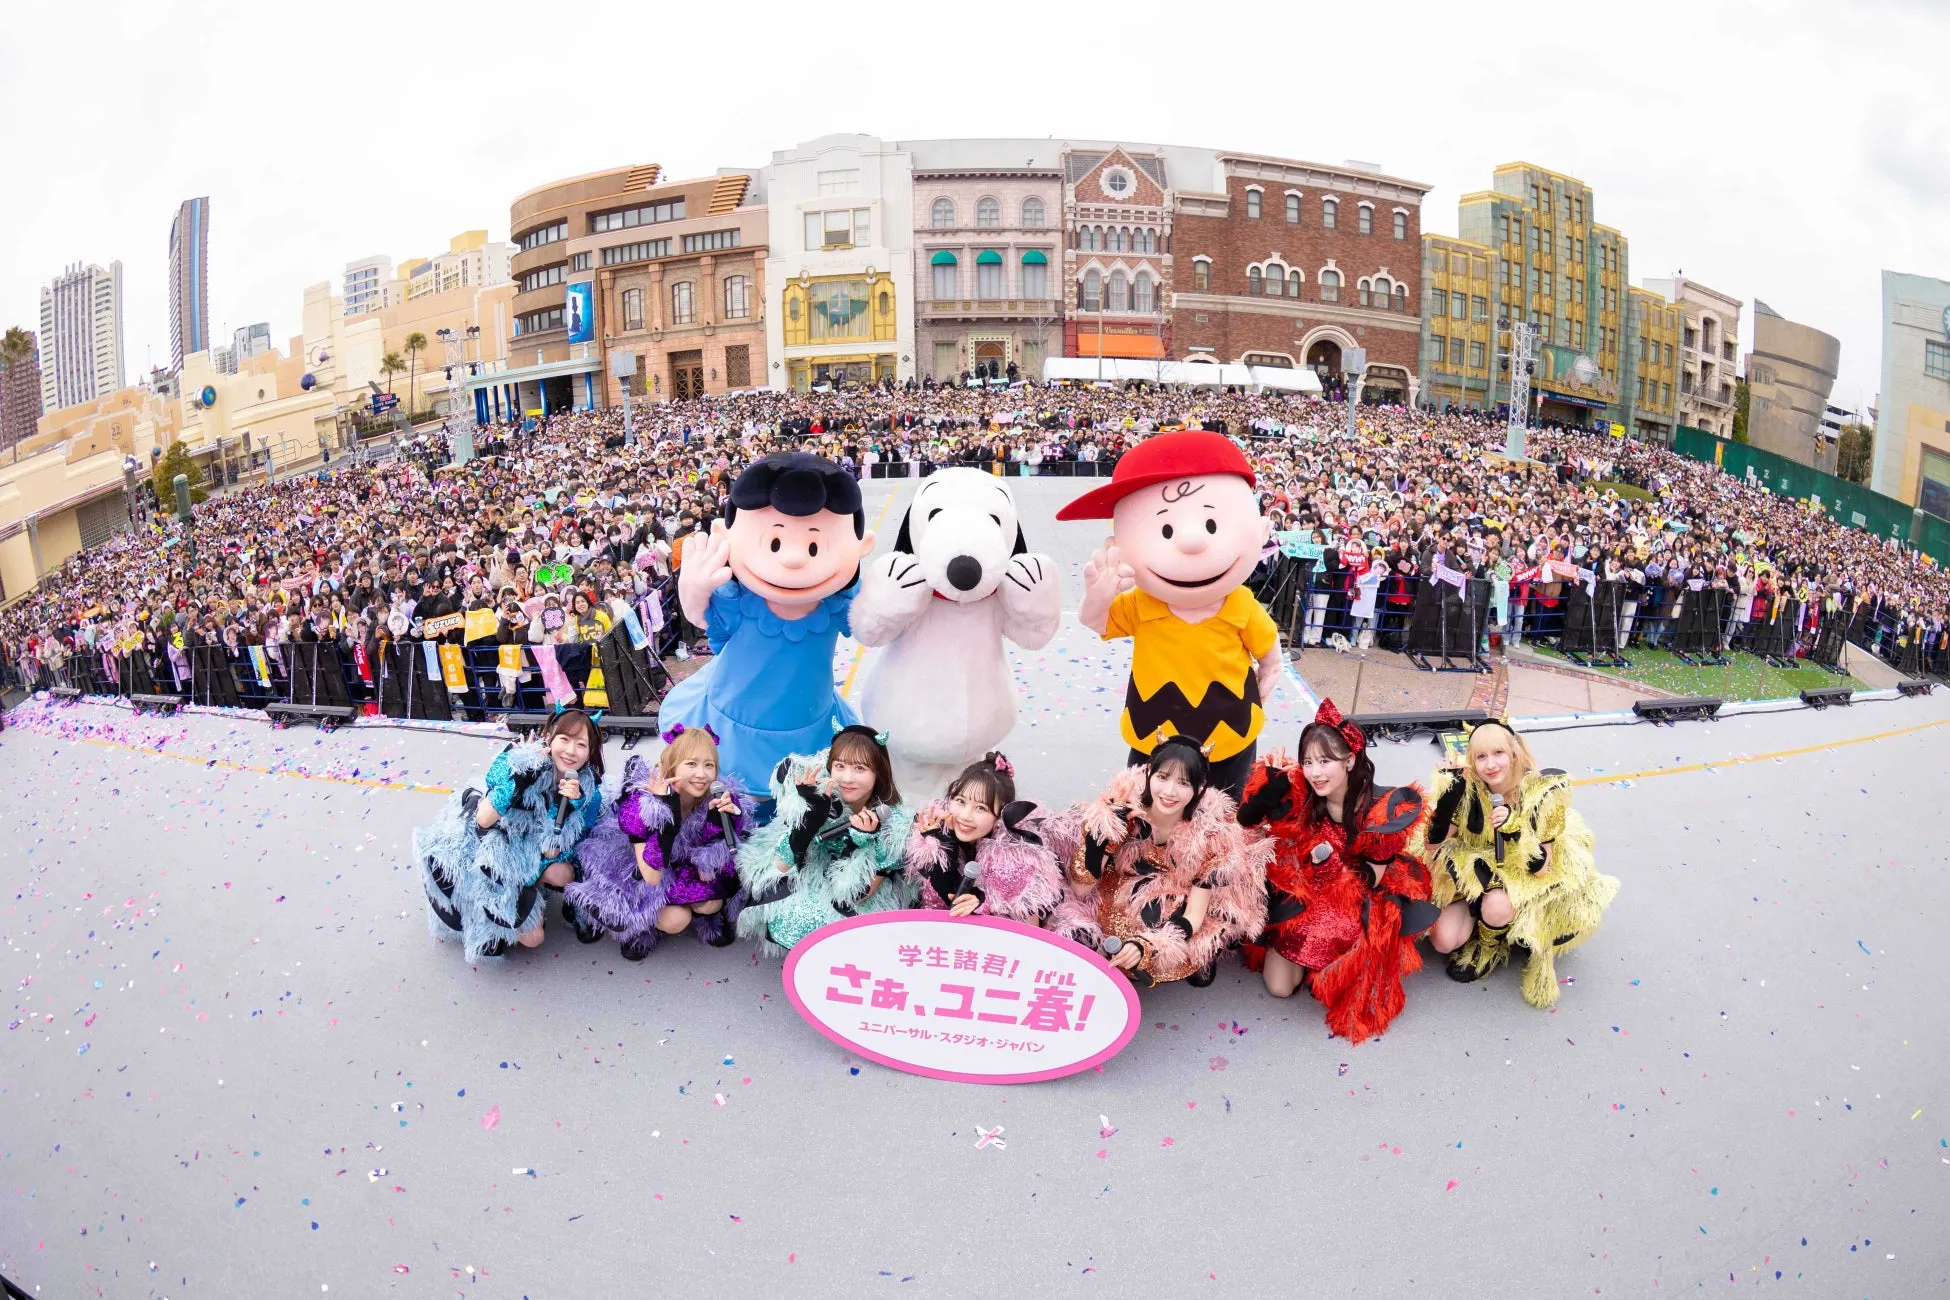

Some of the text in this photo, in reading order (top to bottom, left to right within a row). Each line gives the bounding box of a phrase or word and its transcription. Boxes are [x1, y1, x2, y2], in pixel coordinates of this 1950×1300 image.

[898, 945, 1020, 979] 学生諸君！
[1034, 969, 1077, 986] バル
[858, 1021, 1045, 1053] ユニバーサル・スタジオ・ジャパン
